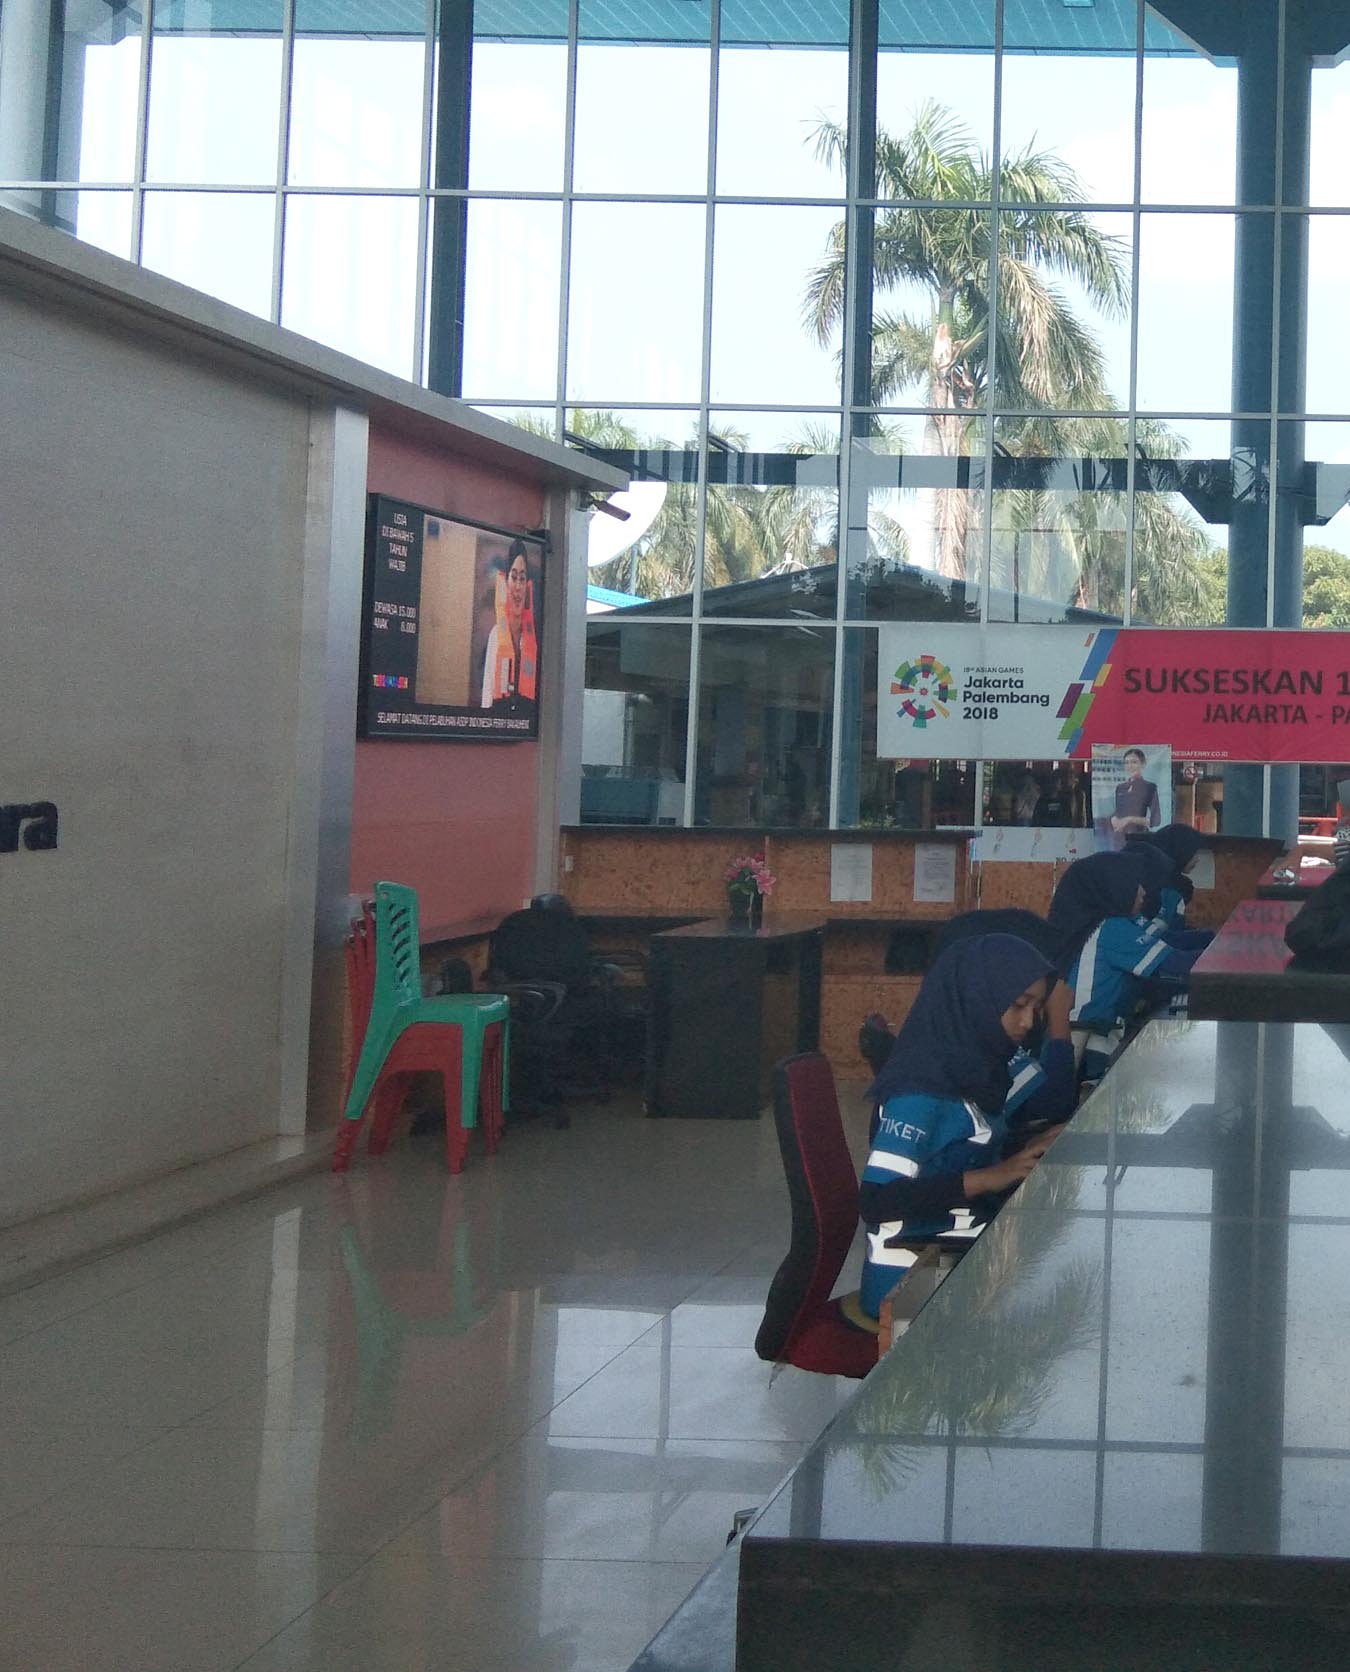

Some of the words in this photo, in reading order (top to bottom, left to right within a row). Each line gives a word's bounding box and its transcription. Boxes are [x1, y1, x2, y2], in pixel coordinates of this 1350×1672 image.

[963, 675, 1024, 689] Jakarta
[1123, 667, 1324, 695] SUKSESKAN
[962, 690, 1051, 707] Palembang
[962, 706, 999, 720] 2018
[1202, 703, 1308, 725] JAKARTA
[879, 1116, 926, 1143] TIKET
